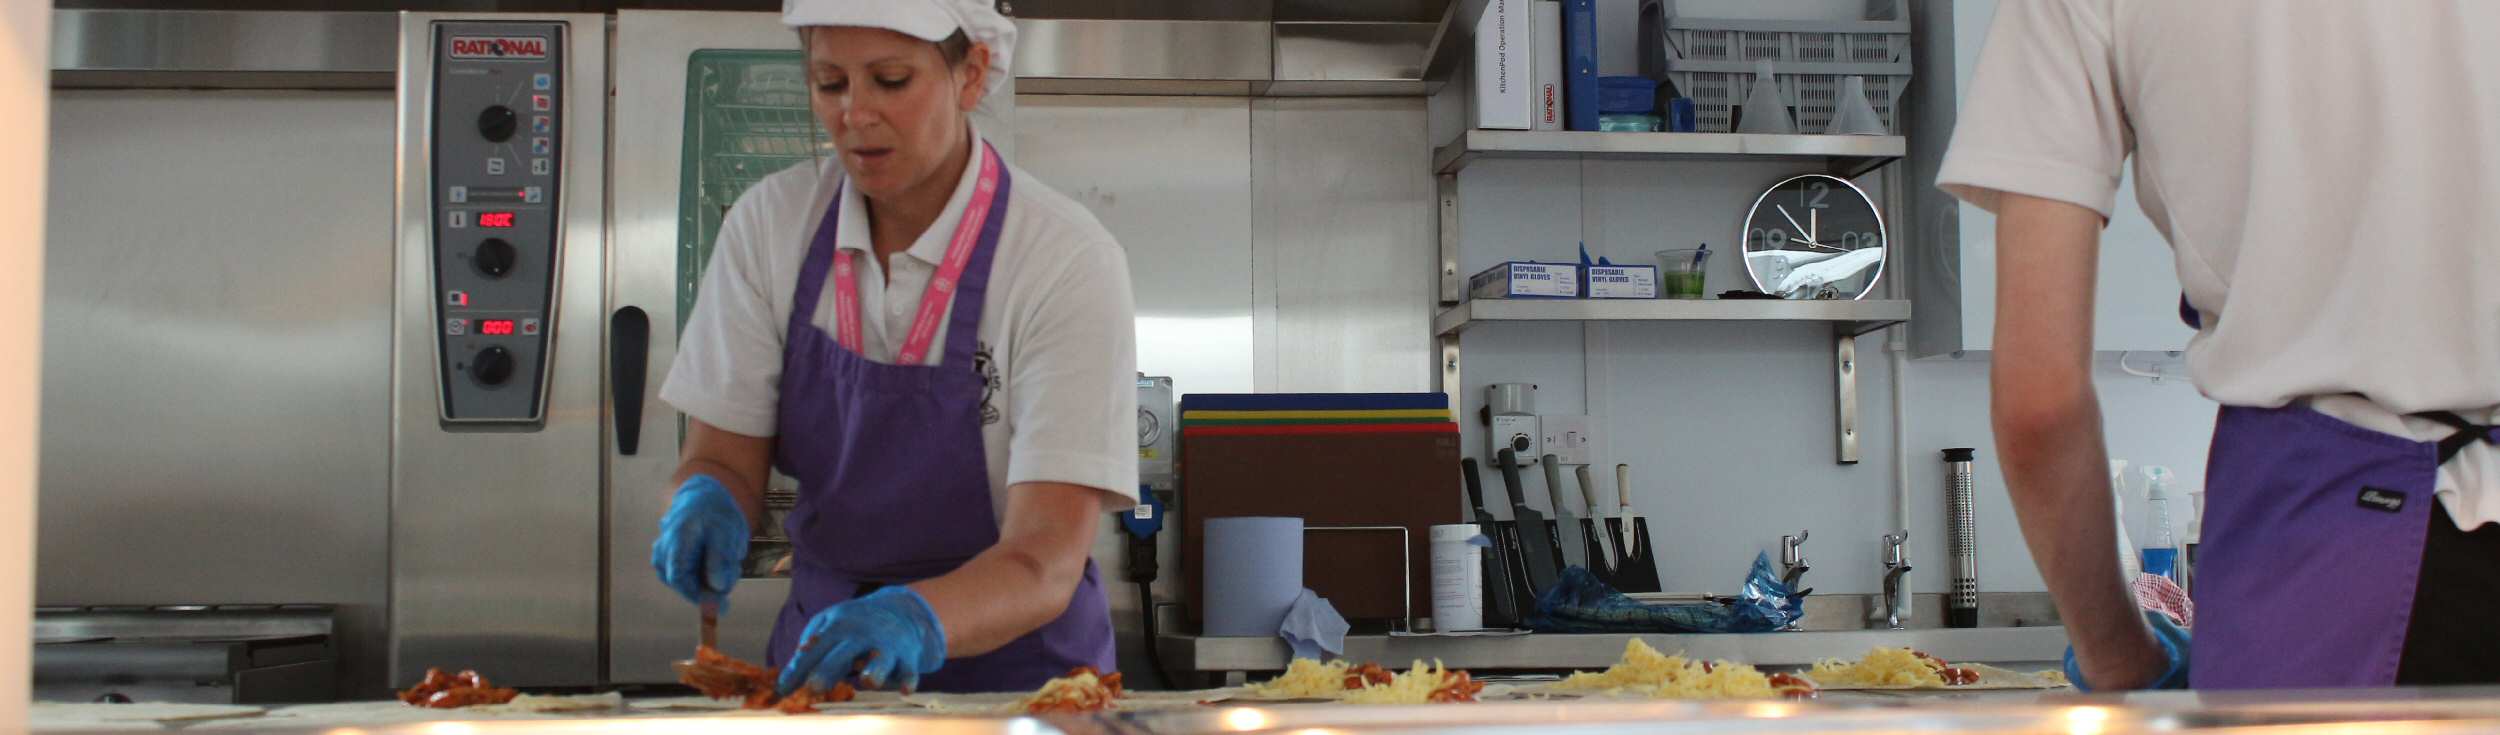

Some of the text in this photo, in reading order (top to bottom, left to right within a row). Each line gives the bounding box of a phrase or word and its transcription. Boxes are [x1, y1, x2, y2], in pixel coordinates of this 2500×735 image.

[453, 39, 545, 56] RATIONAL
[1498, 15, 1506, 50] Operation
[1499, 52, 1507, 94] KitchenPod
[1545, 85, 1553, 122] RATIONAL
[1800, 181, 1830, 208] 12
[1513, 265, 1546, 273] DISPOSABLE
